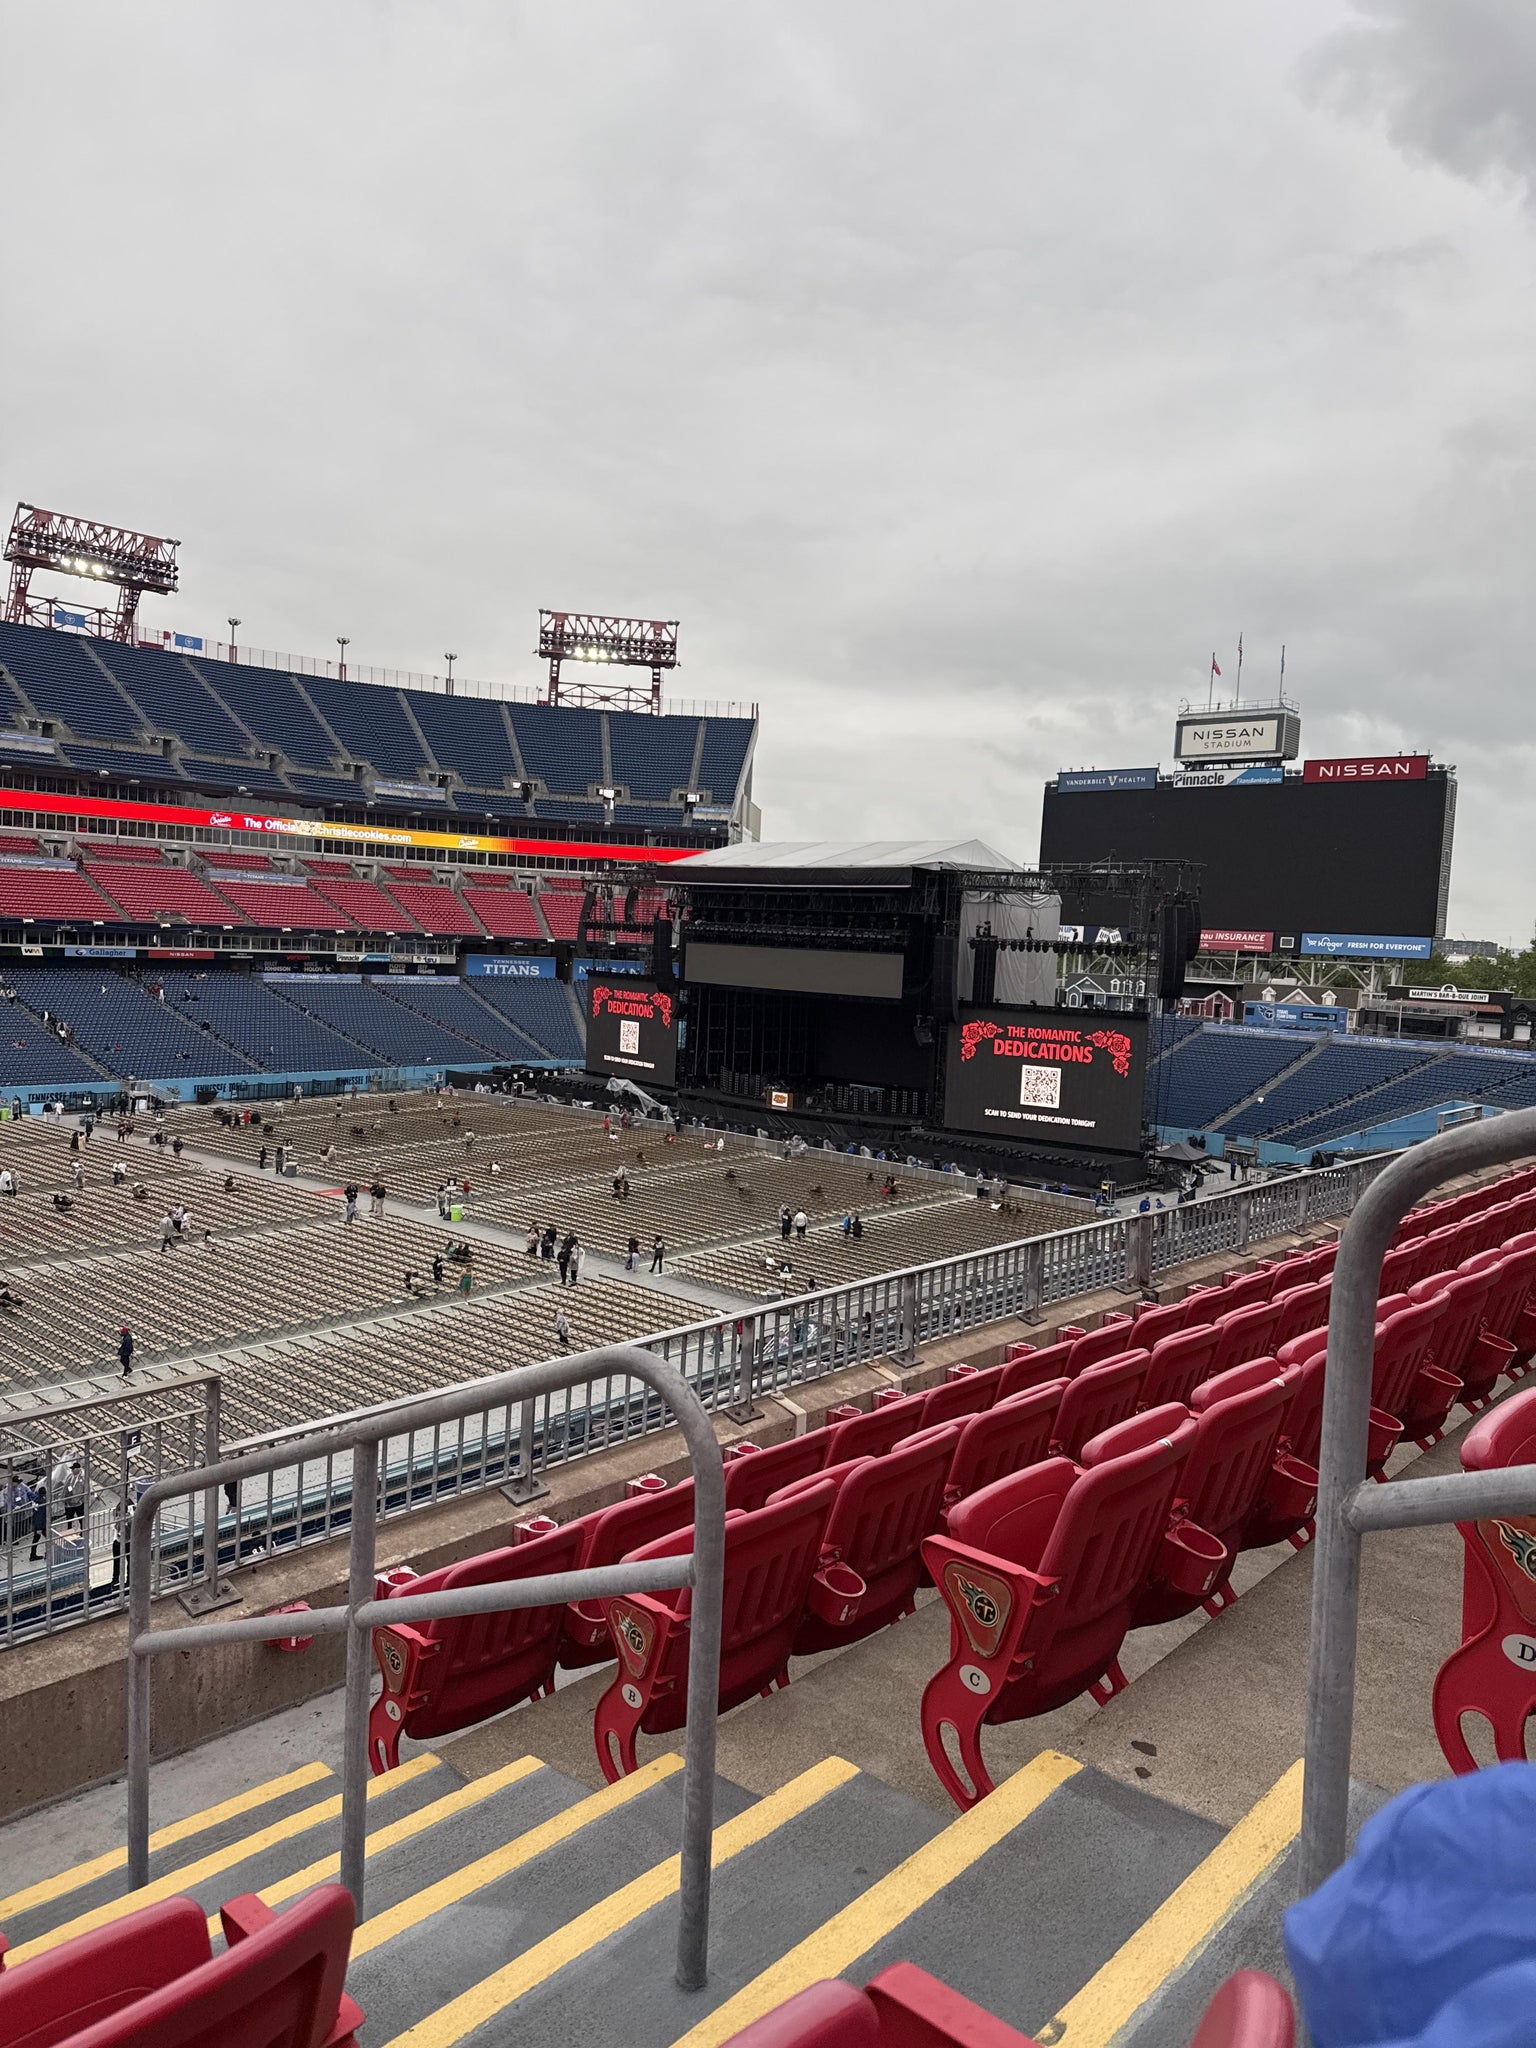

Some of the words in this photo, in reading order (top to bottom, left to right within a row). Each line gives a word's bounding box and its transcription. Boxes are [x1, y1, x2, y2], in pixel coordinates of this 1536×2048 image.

[1193, 727, 1264, 740] NISSAN
[1204, 740, 1251, 749] STADIUM
[1319, 762, 1410, 777] NISSAN
[1066, 778, 1106, 786] VANDERBILT
[1119, 776, 1146, 784] HEALTH
[1174, 772, 1225, 787] Pinnacle
[243, 817, 262, 829] The
[264, 819, 297, 832] Officia
[319, 825, 412, 843] christiecookies.com
[1215, 933, 1266, 942] INSURANCE
[1318, 937, 1343, 951] Kroger
[1370, 942, 1384, 950] FOR
[89, 948, 127, 957] Gallagher
[483, 964, 540, 976] TITANS
[613, 989, 623, 999] THE
[623, 991, 649, 1002] ROMANTIC
[607, 999, 654, 1019] DEDICATIONS
[1006, 1025, 1026, 1038] THE
[1027, 1027, 1082, 1043] ROMANTIC
[993, 1039, 1094, 1064] DEDICATIONS
[984, 1108, 999, 1117] SCAN
[999, 1109, 1007, 1118] TO
[1007, 1110, 1022, 1119] SEND
[1022, 1112, 1037, 1121] YOUR
[1038, 1114, 1070, 1125] DEDICATION
[1071, 1118, 1096, 1128] TONIGHT
[783, 1265, 790, 1273] A
[131, 1435, 138, 1445] F
[1517, 1642, 1536, 1663] D
[969, 1672, 980, 1687] C
[628, 1689, 636, 1702] B
[389, 1706, 397, 1717] A
